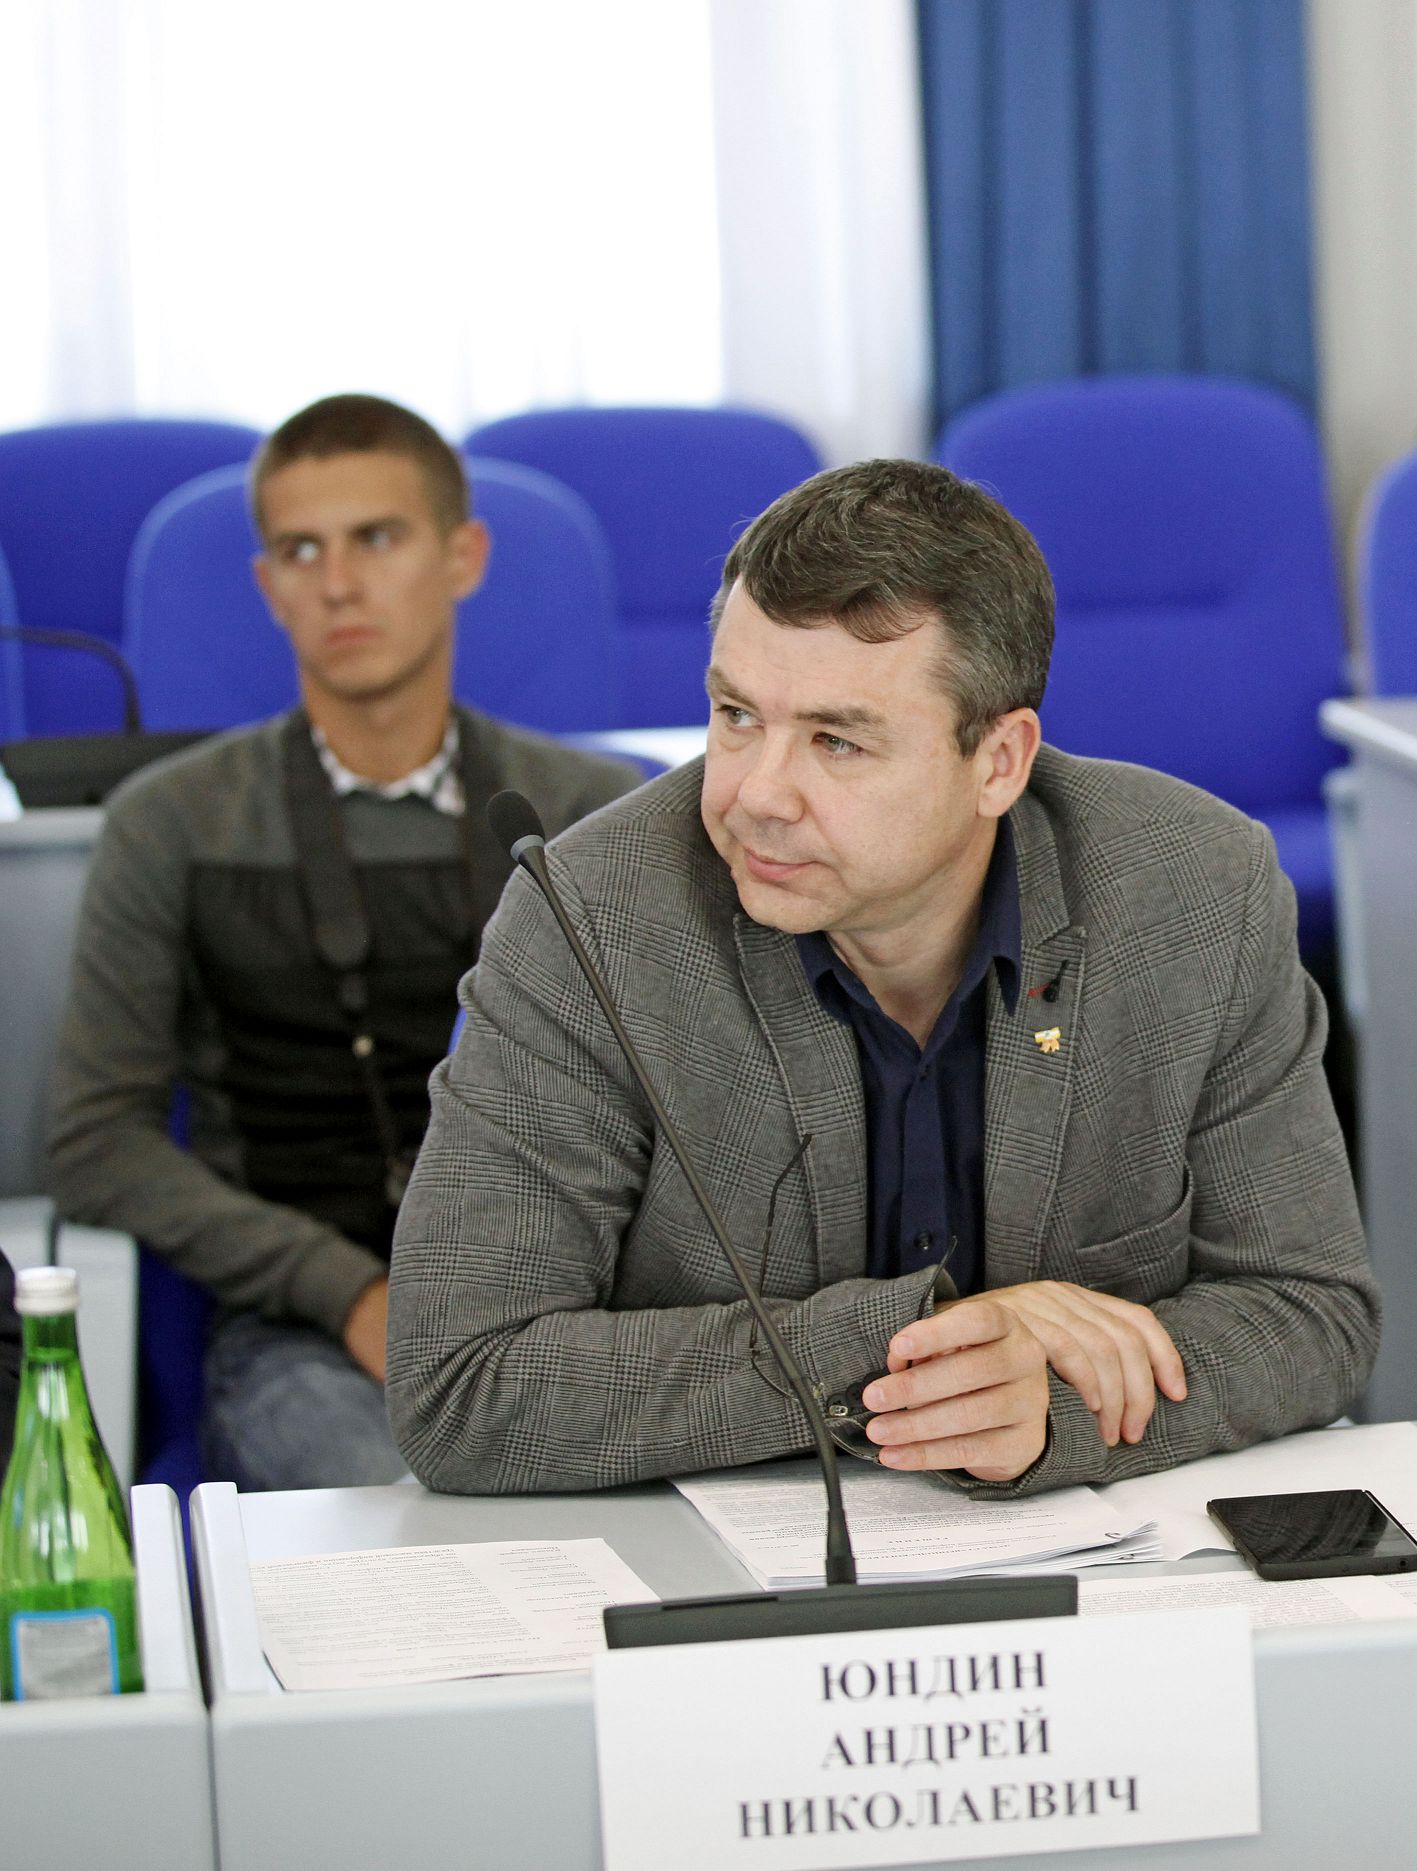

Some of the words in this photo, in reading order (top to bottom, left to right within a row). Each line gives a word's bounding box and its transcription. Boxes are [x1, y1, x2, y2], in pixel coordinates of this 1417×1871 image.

[820, 1650, 1046, 1702] ЮНДИН
[822, 1706, 1050, 1768] АНДРЕЙ
[738, 1776, 1139, 1839] НИКОЛАЕВИЧ
